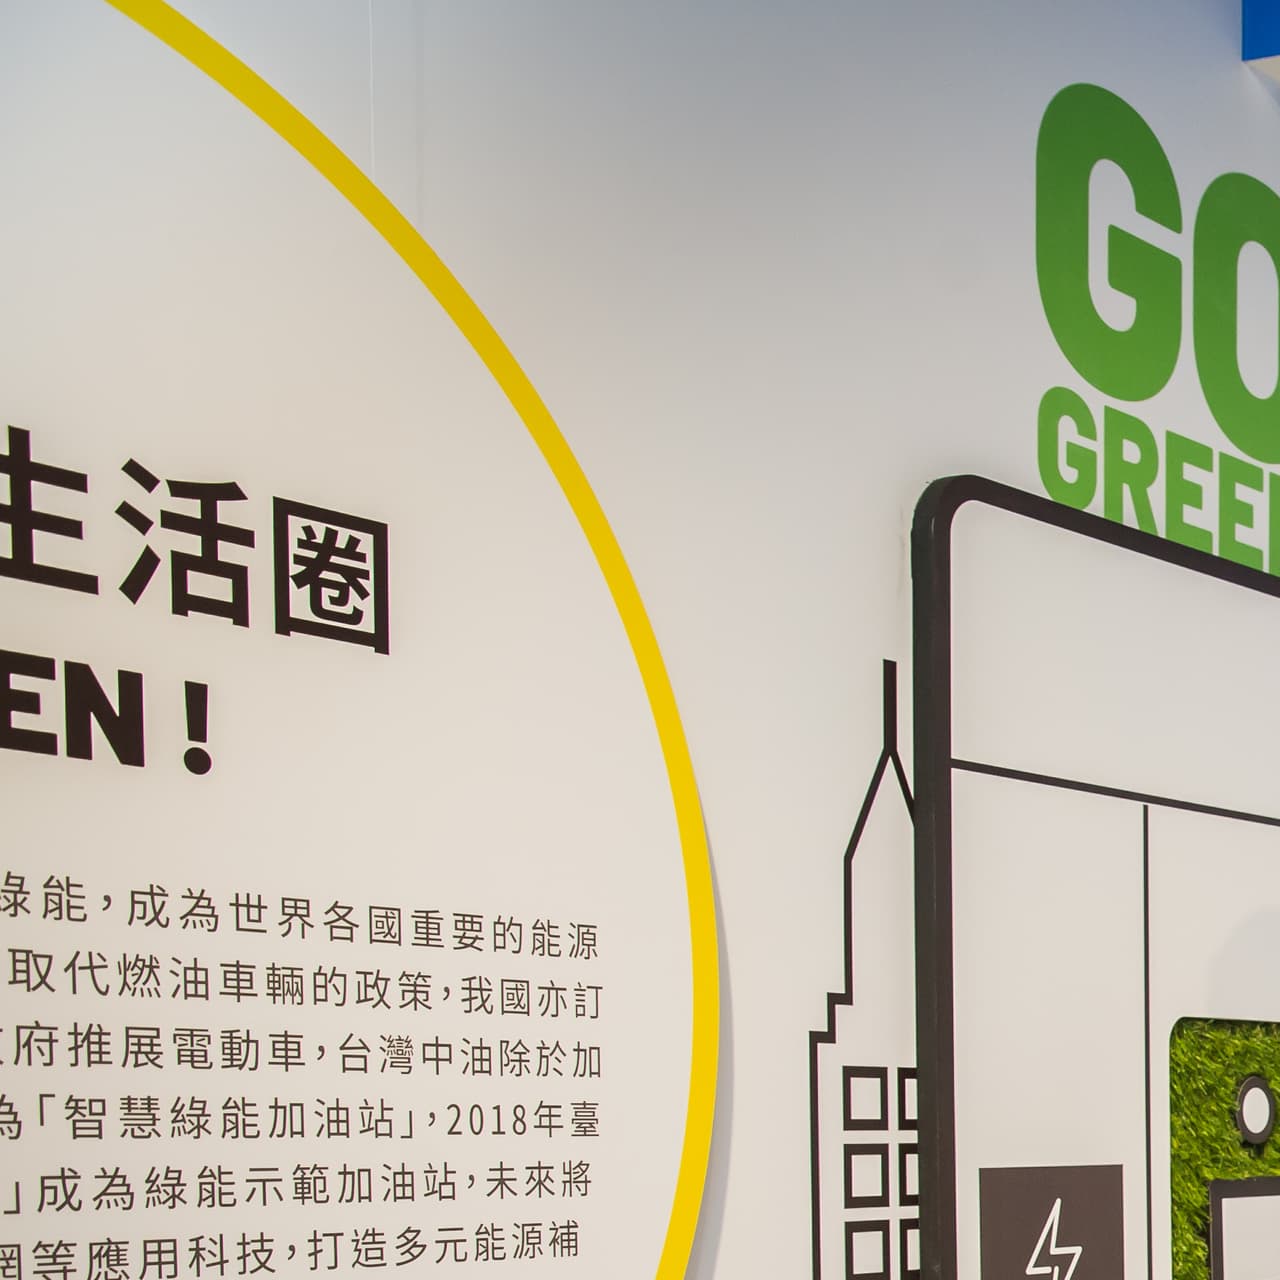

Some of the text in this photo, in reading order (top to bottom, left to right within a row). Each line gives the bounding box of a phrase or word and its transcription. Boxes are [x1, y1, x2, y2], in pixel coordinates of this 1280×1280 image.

[0, 1019, 601, 1079] 府推展電動車，台灣中油除於加
